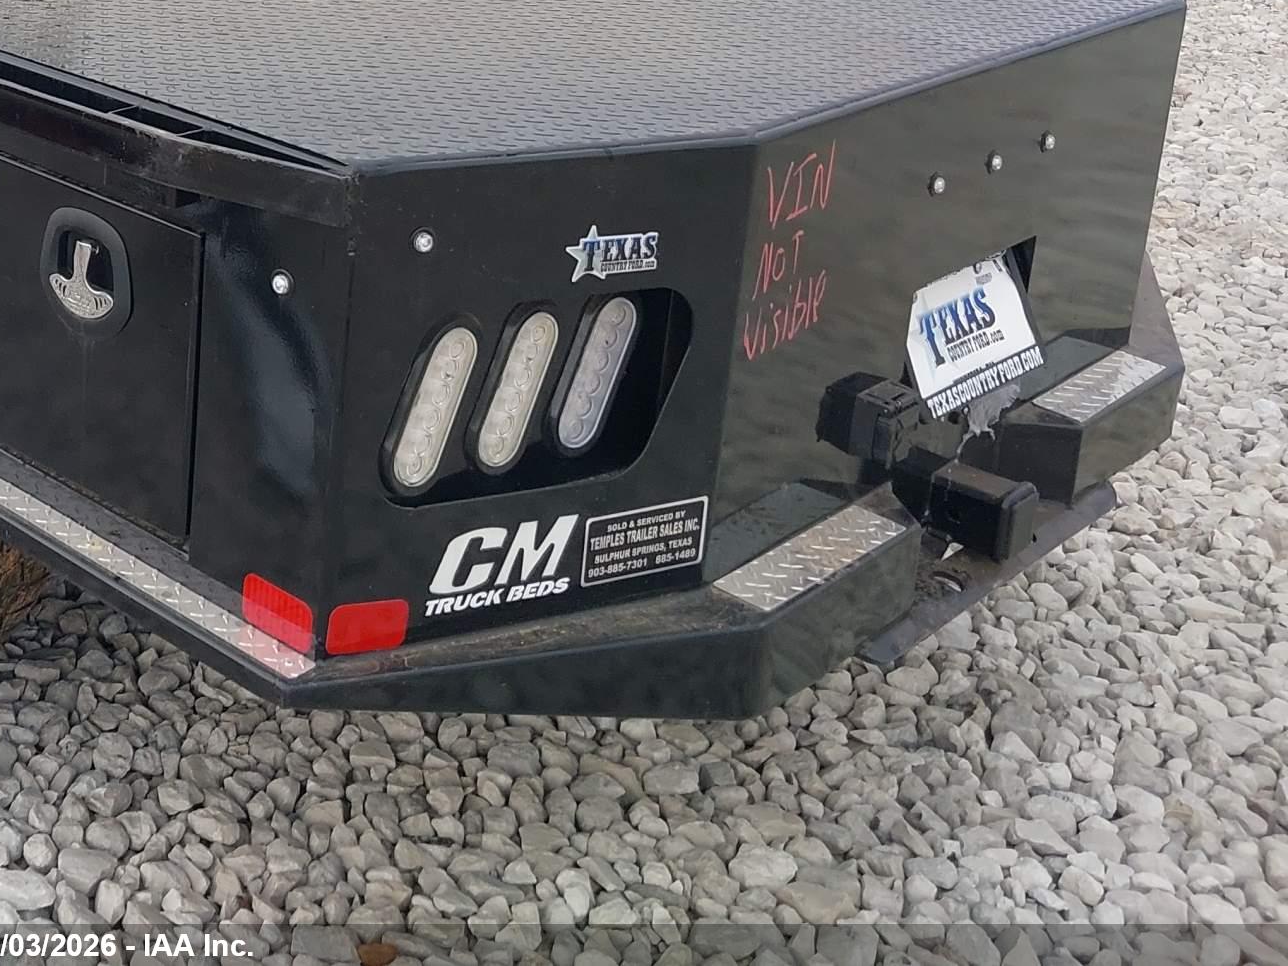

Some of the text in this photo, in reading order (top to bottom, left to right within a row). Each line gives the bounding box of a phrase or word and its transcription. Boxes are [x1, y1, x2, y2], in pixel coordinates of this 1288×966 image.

[767, 138, 836, 230] VIN
[583, 235, 657, 272] TEXAS
[918, 286, 996, 367] TEXAS
[946, 336, 976, 362] COUNTRY
[590, 518, 700, 551] TEMPLES TRAILER SALES INC.
[607, 521, 628, 532] SOLD
[636, 512, 674, 527] SERVICED
[675, 510, 686, 519] BY
[428, 513, 580, 595] CM
[588, 548, 696, 578] 903-885-7301 885-1489
[594, 536, 693, 565] SULPHUR SPRINGS, TEXAS
[424, 577, 571, 617] TRUCK BEDS
